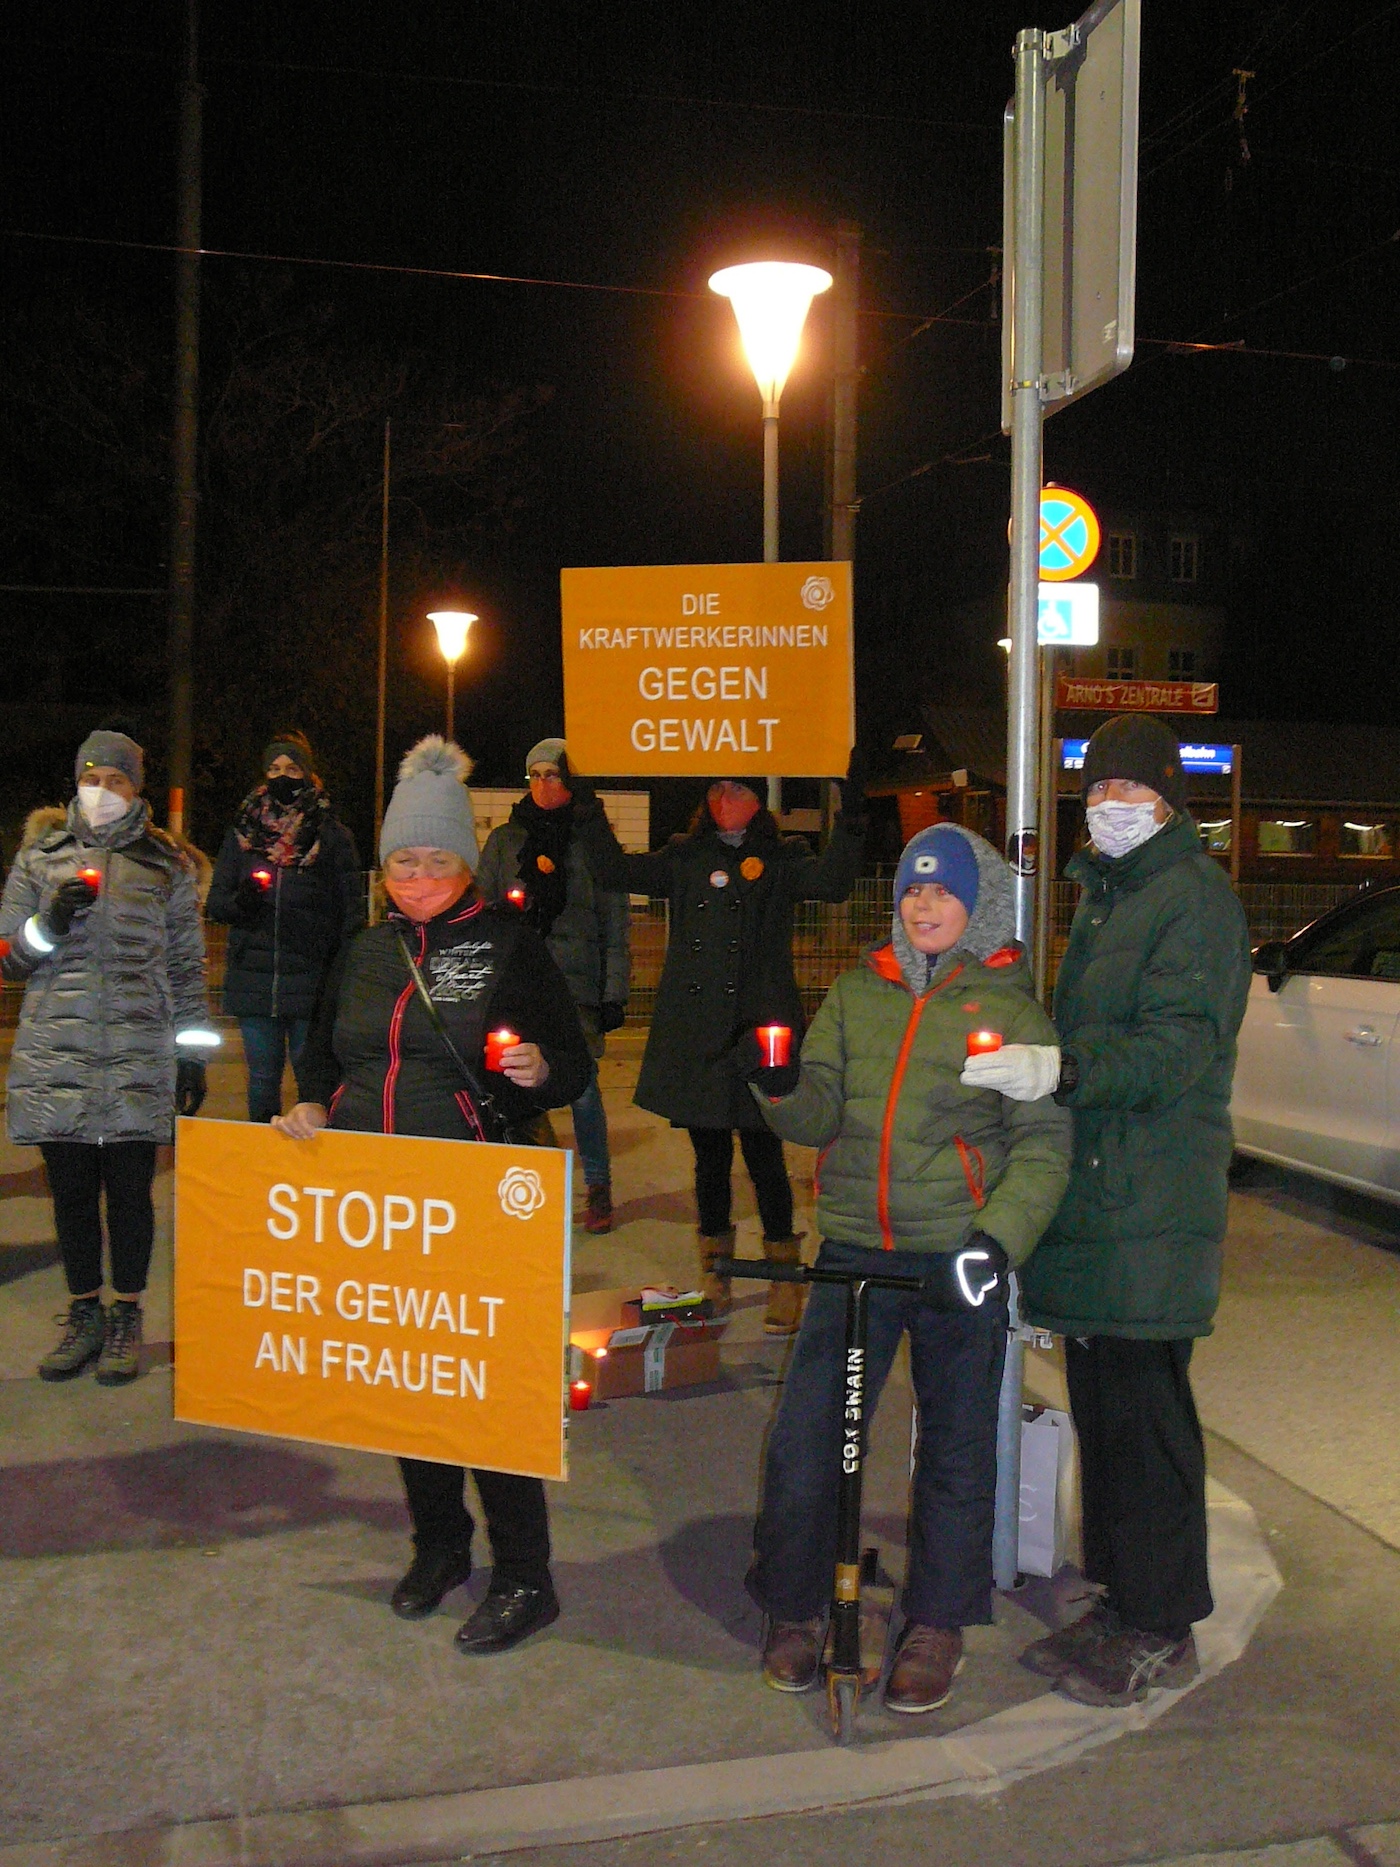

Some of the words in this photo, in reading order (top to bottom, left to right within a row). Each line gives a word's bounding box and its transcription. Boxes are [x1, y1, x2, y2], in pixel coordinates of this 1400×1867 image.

[681, 592, 721, 616] DIE
[578, 624, 829, 650] KRAFTWERKERINNEN
[638, 666, 768, 701] GEGEN
[1119, 687, 1184, 707] ZENTRALE
[630, 717, 780, 753] GEWALT
[265, 1182, 457, 1256] STOPP
[242, 1267, 322, 1318] DER
[334, 1279, 505, 1339] GEWALT
[254, 1330, 307, 1376] AN
[321, 1339, 487, 1401] FRAUEN
[845, 1347, 865, 1421] SWAIN
